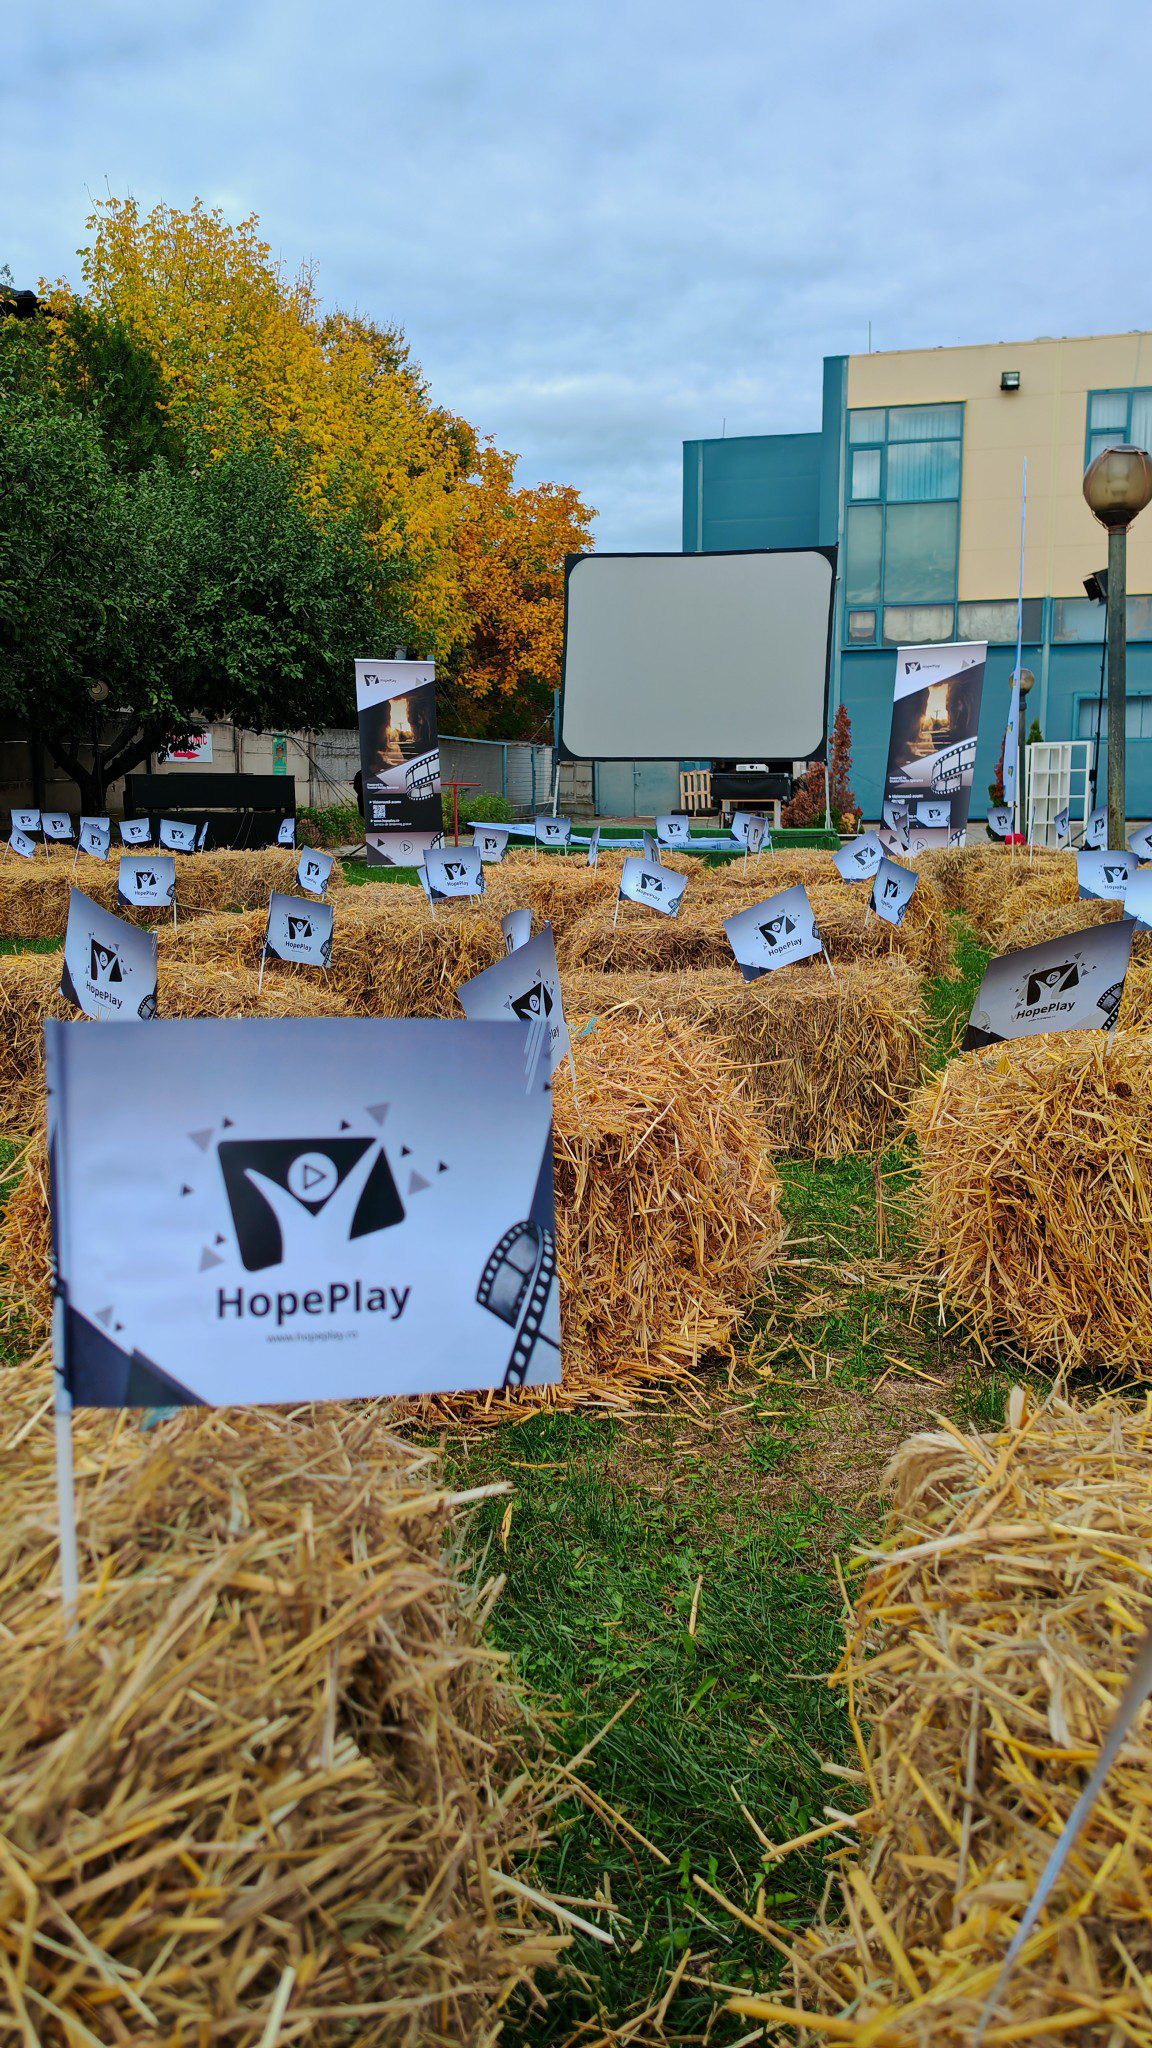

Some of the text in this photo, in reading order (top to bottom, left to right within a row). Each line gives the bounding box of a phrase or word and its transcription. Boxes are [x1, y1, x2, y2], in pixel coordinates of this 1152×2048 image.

[285, 940, 313, 951] HopePlay
[768, 938, 802, 957] HopePlay
[86, 980, 124, 1010] HopePlay
[1016, 1001, 1077, 1020] HopePlay
[216, 1278, 412, 1328] HopePlay
